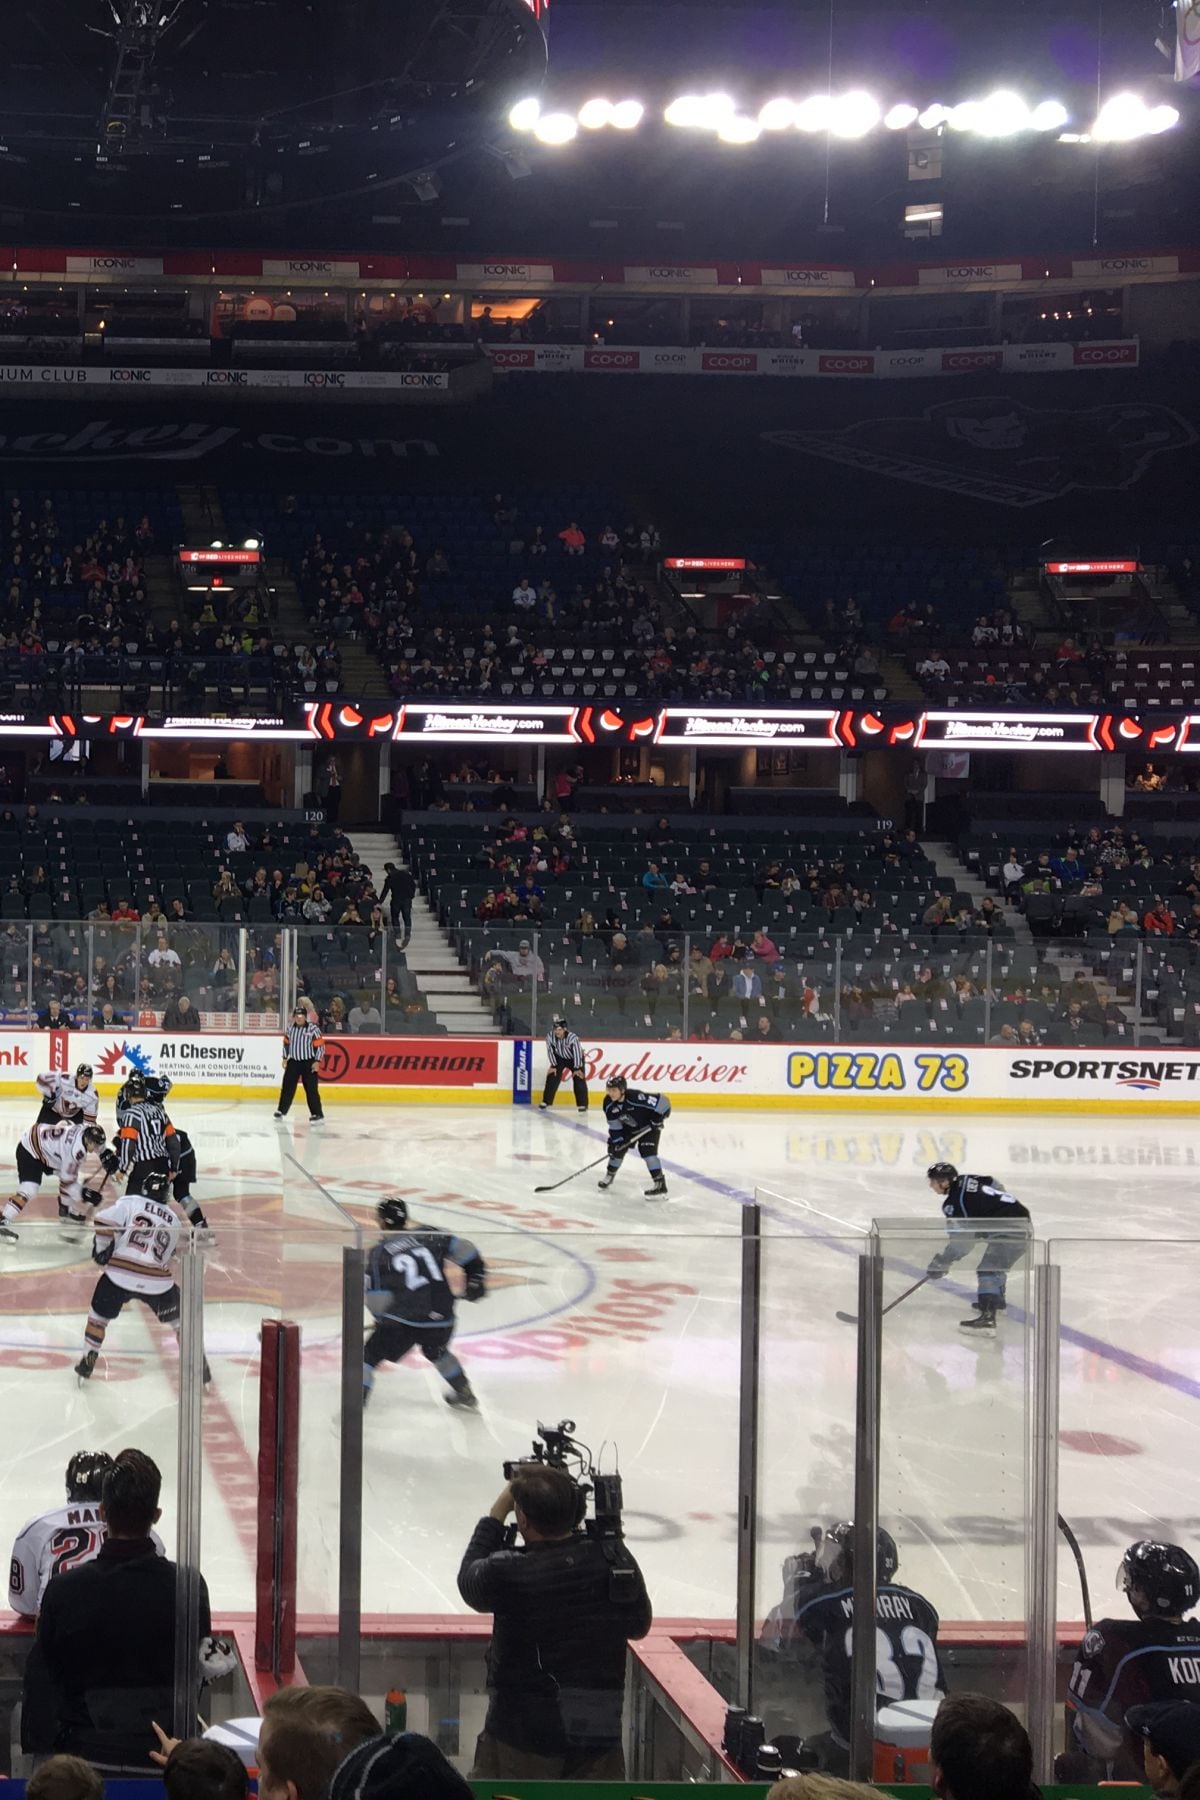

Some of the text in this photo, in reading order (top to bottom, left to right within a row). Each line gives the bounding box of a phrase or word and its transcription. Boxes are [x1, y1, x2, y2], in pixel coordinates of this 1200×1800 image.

[93, 258, 136, 269] ICONIC
[289, 261, 331, 272] ICONIC
[1101, 258, 1149, 269] ICONIC
[483, 265, 525, 275] ICONIC
[649, 268, 691, 278] ICONIC
[786, 270, 829, 281] ICONIC
[946, 267, 993, 278] ICONIC
[590, 354, 633, 365] CO-OP
[1080, 349, 1128, 360] CO-OP
[708, 355, 751, 366] CO-OP
[825, 359, 867, 370] CO-OP
[41, 369, 87, 382] CLUB
[109, 369, 151, 381] ICONIC
[206, 371, 248, 383] ICONIC
[303, 373, 345, 385] ICONIC
[401, 375, 442, 386] ICONIC
[422, 714, 544, 733] HitmenHockey.com
[684, 718, 805, 737] HitmenHockey.com
[944, 721, 1064, 741] HitmenHockey.com
[305, 811, 323, 821] 120
[877, 820, 893, 830] 119
[160, 1043, 244, 1063] A1 Chesney
[356, 1053, 485, 1072] WARRIOR
[787, 1052, 969, 1092] PIZZA 73
[144, 1202, 174, 1225] ELDER
[128, 1214, 171, 1261] 29
[1184, 1584, 1193, 1596] 11
[1069, 1660, 1092, 1699] 11
